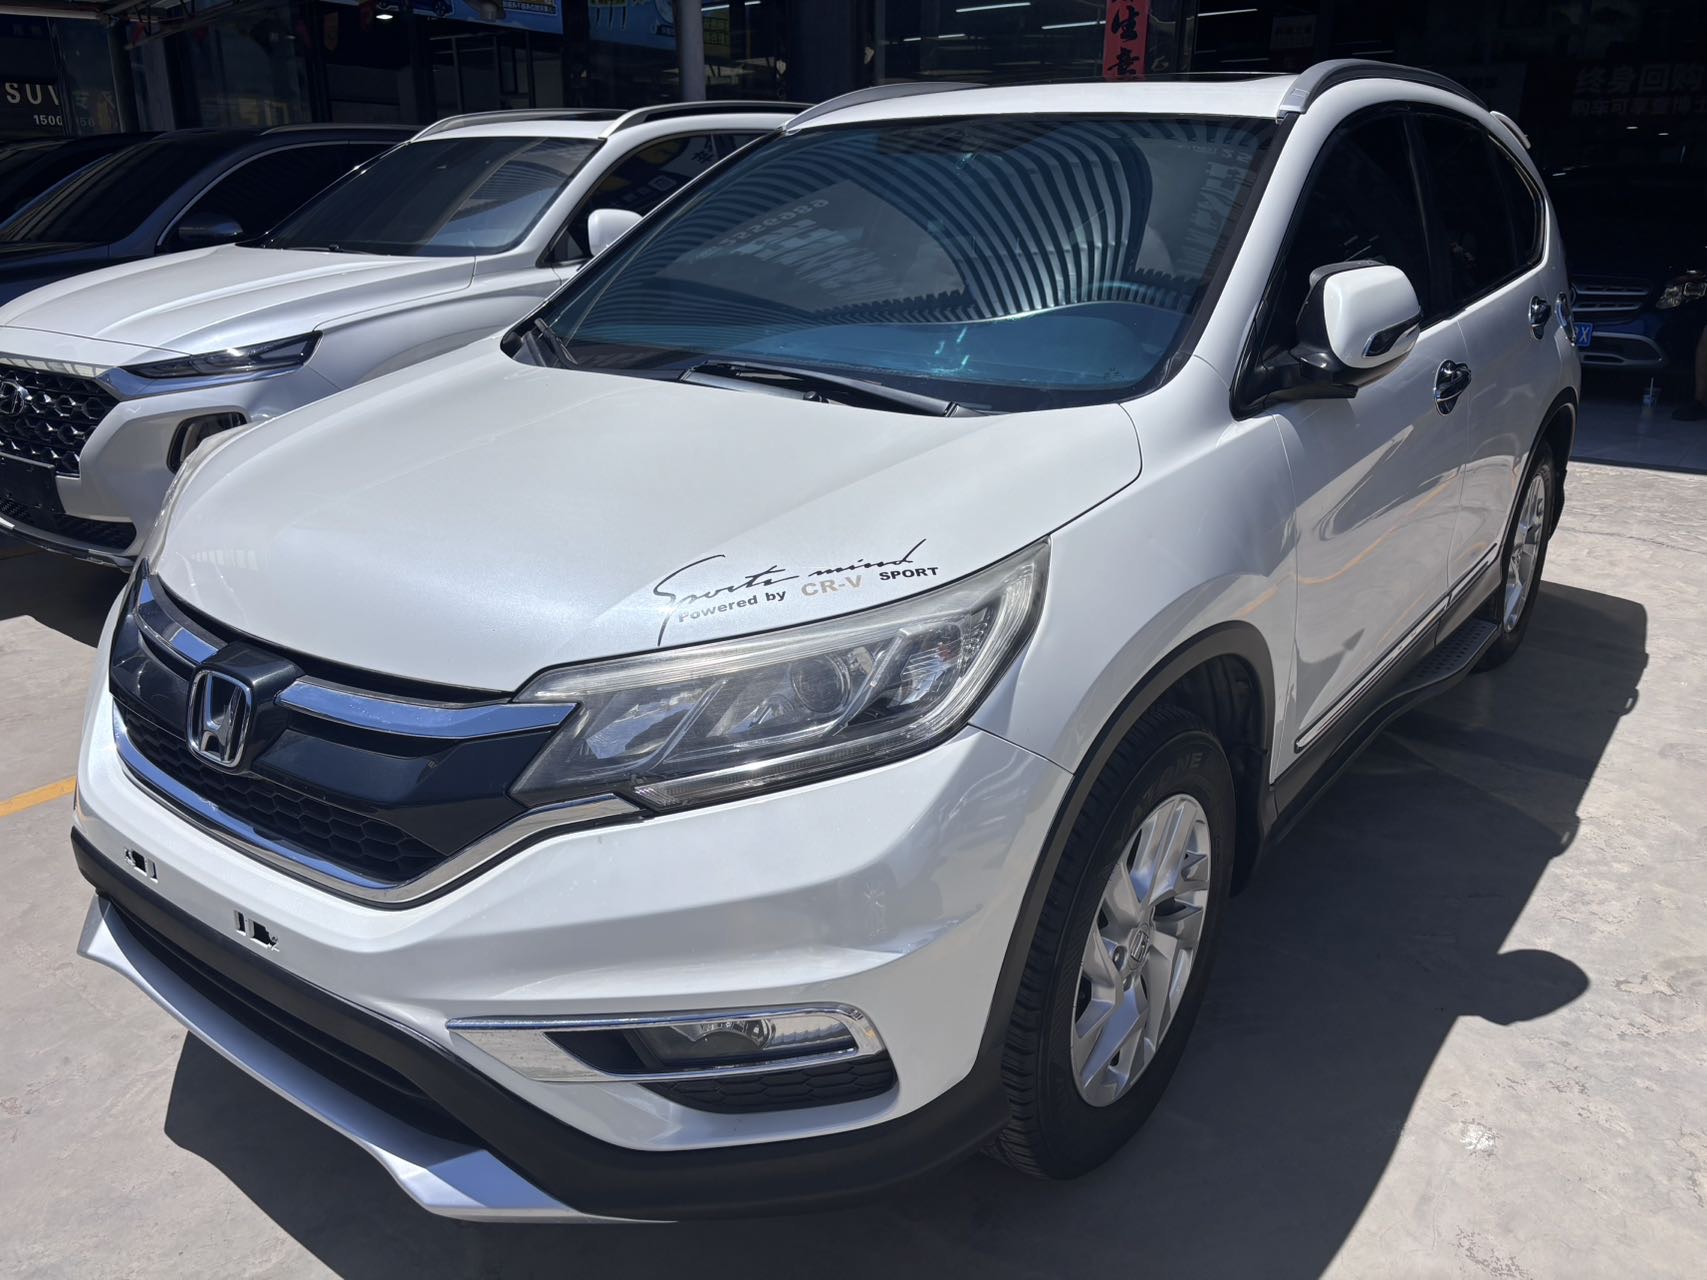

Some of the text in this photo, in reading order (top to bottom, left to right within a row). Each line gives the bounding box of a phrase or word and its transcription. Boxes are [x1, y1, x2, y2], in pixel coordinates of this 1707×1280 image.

[1572, 63, 1705, 95] 终身回购
[653, 538, 927, 647] Sports mind
[678, 566, 940, 623] Powered by CR-V SPORT
